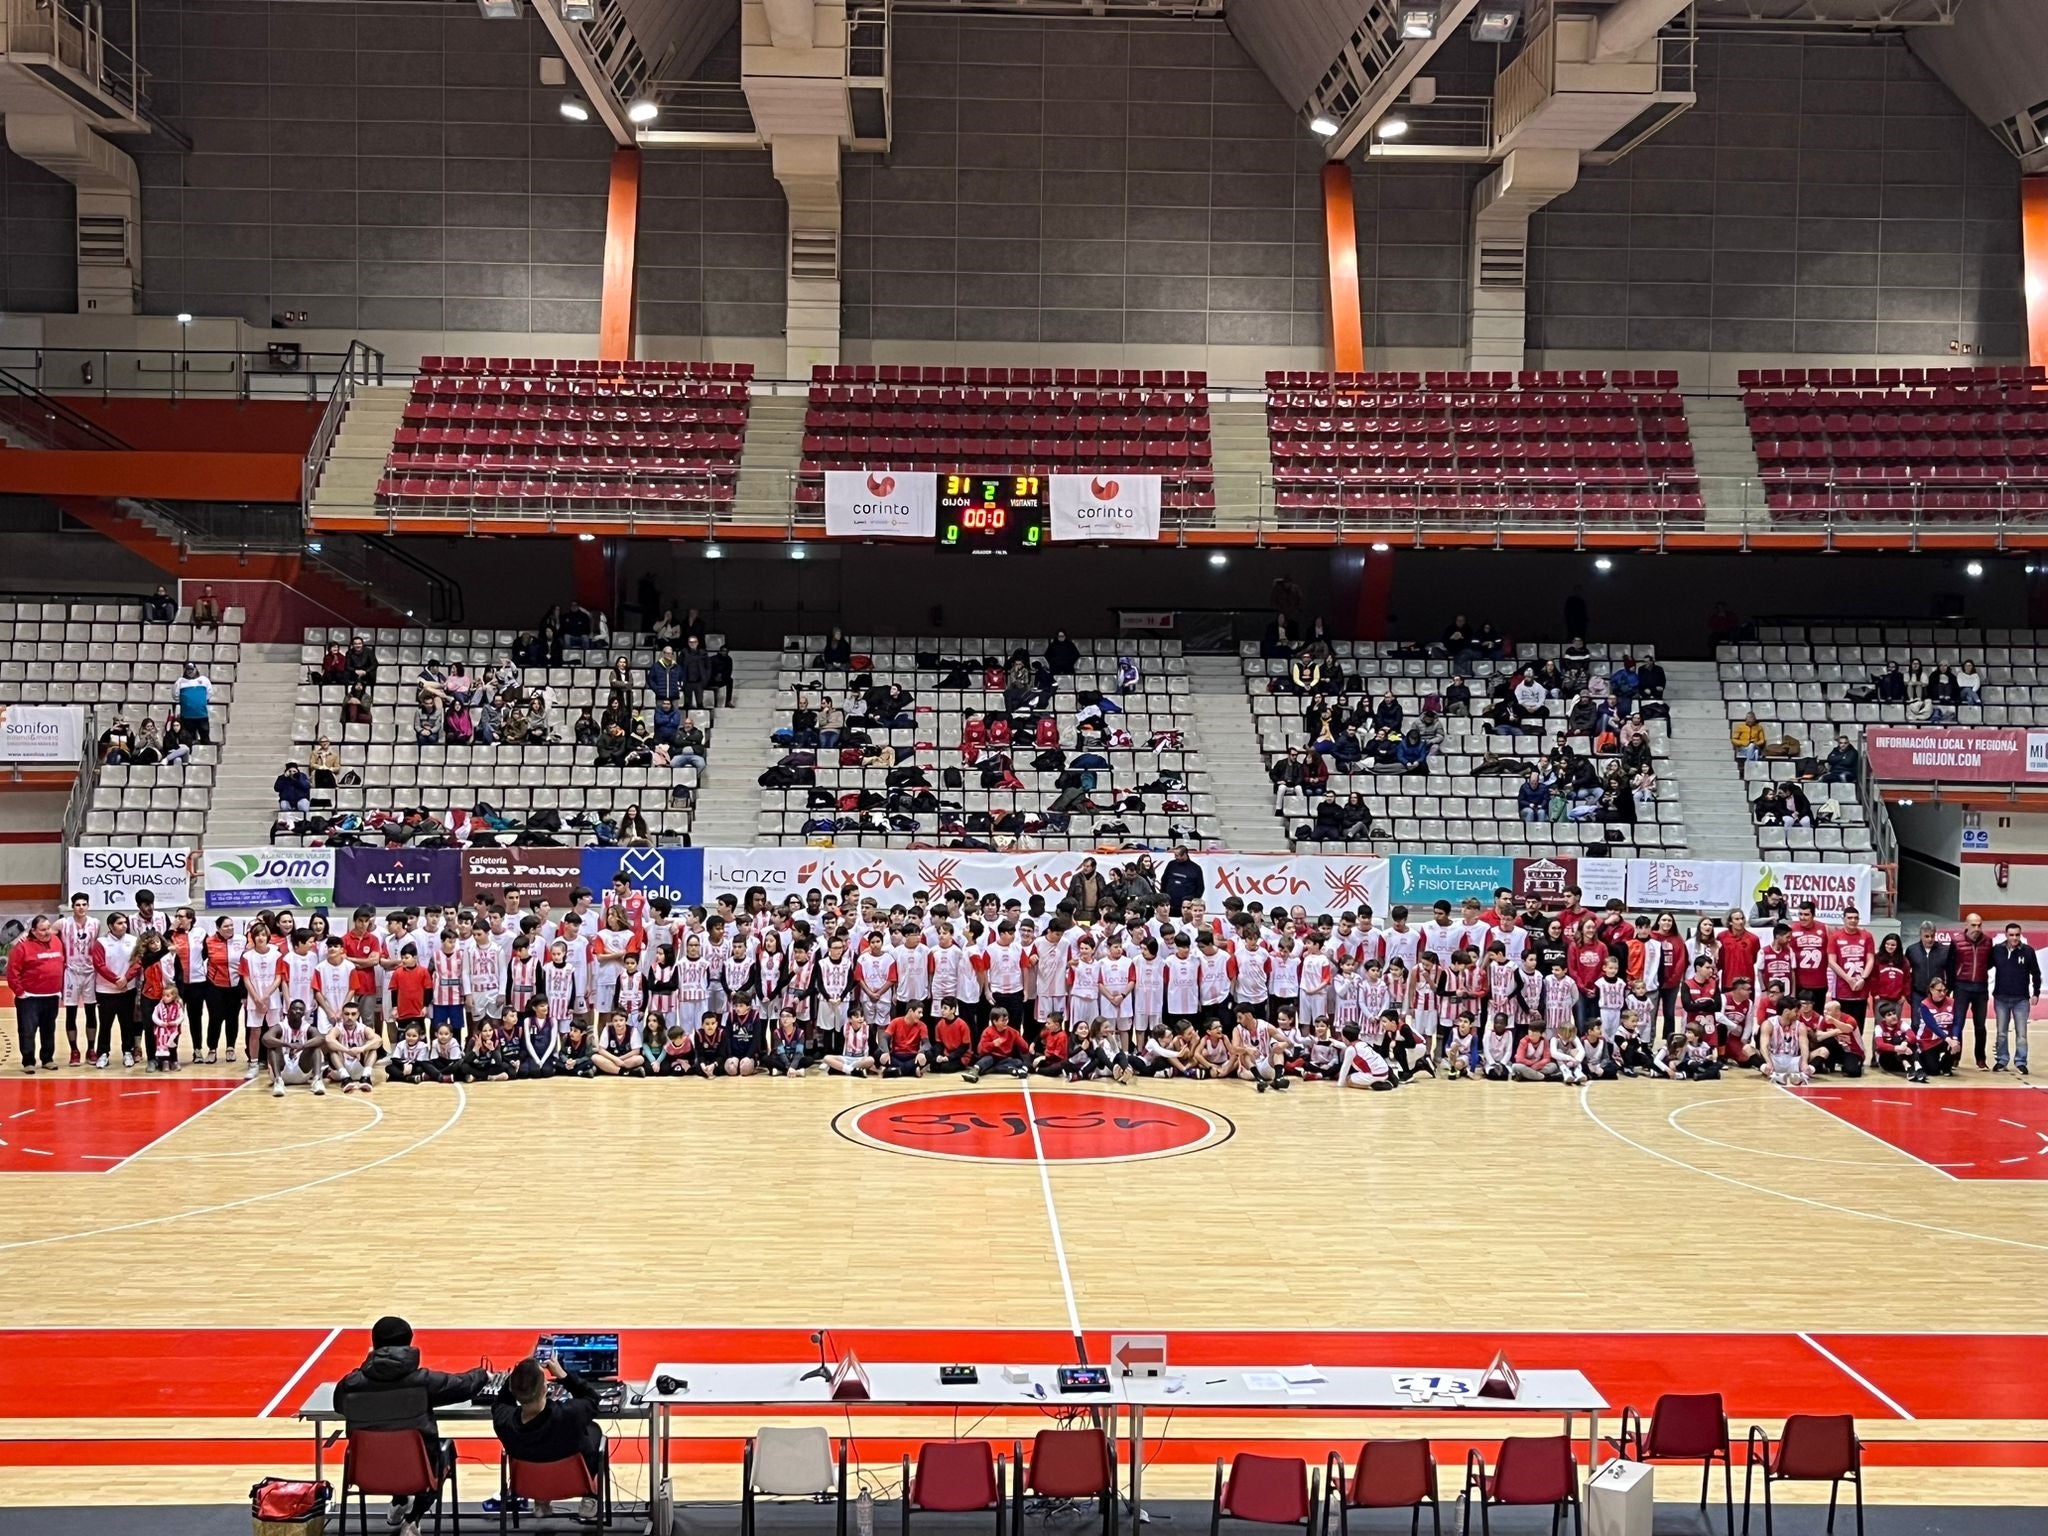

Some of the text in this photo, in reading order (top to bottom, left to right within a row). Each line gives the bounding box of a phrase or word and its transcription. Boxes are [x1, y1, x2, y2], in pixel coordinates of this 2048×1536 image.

[947, 476, 970, 495] 31
[1016, 477, 1038, 495] 37
[984, 485, 995, 500] 2
[853, 502, 909, 515] corinto
[942, 498, 970, 506] GIJÓN
[1011, 499, 1038, 507] VISITANTE
[964, 509, 1004, 527] 00:0
[1078, 505, 1133, 518] corinto
[947, 525, 958, 540] 0
[1028, 527, 1039, 541] 0
[7, 722, 58, 734] sonifon
[1876, 736, 2018, 751] INFORMACIÓN LOCAL Y REGIONAL
[2030, 744, 2043, 758] MI
[1912, 752, 1981, 767] MIGIJON.COM
[84, 853, 186, 872] ESQUELAS
[469, 856, 507, 865] Cafetería
[469, 865, 580, 876] Don Pelayo
[1419, 864, 1500, 877] Pedro Laverde
[1666, 865, 1694, 878] Faro
[82, 874, 187, 885] DEASTURIAS.COM
[366, 873, 431, 884] ALTAFIT
[1784, 875, 1856, 892] TECNICAS
[1418, 880, 1499, 891] FISIOTERAPIA
[1670, 879, 1699, 892] Piles
[1800, 949, 1822, 969] 29
[2018, 956, 2025, 964] H
[1844, 962, 1864, 980] 25
[1422, 1377, 1441, 1388] 1
[1449, 1381, 1470, 1393] 3
